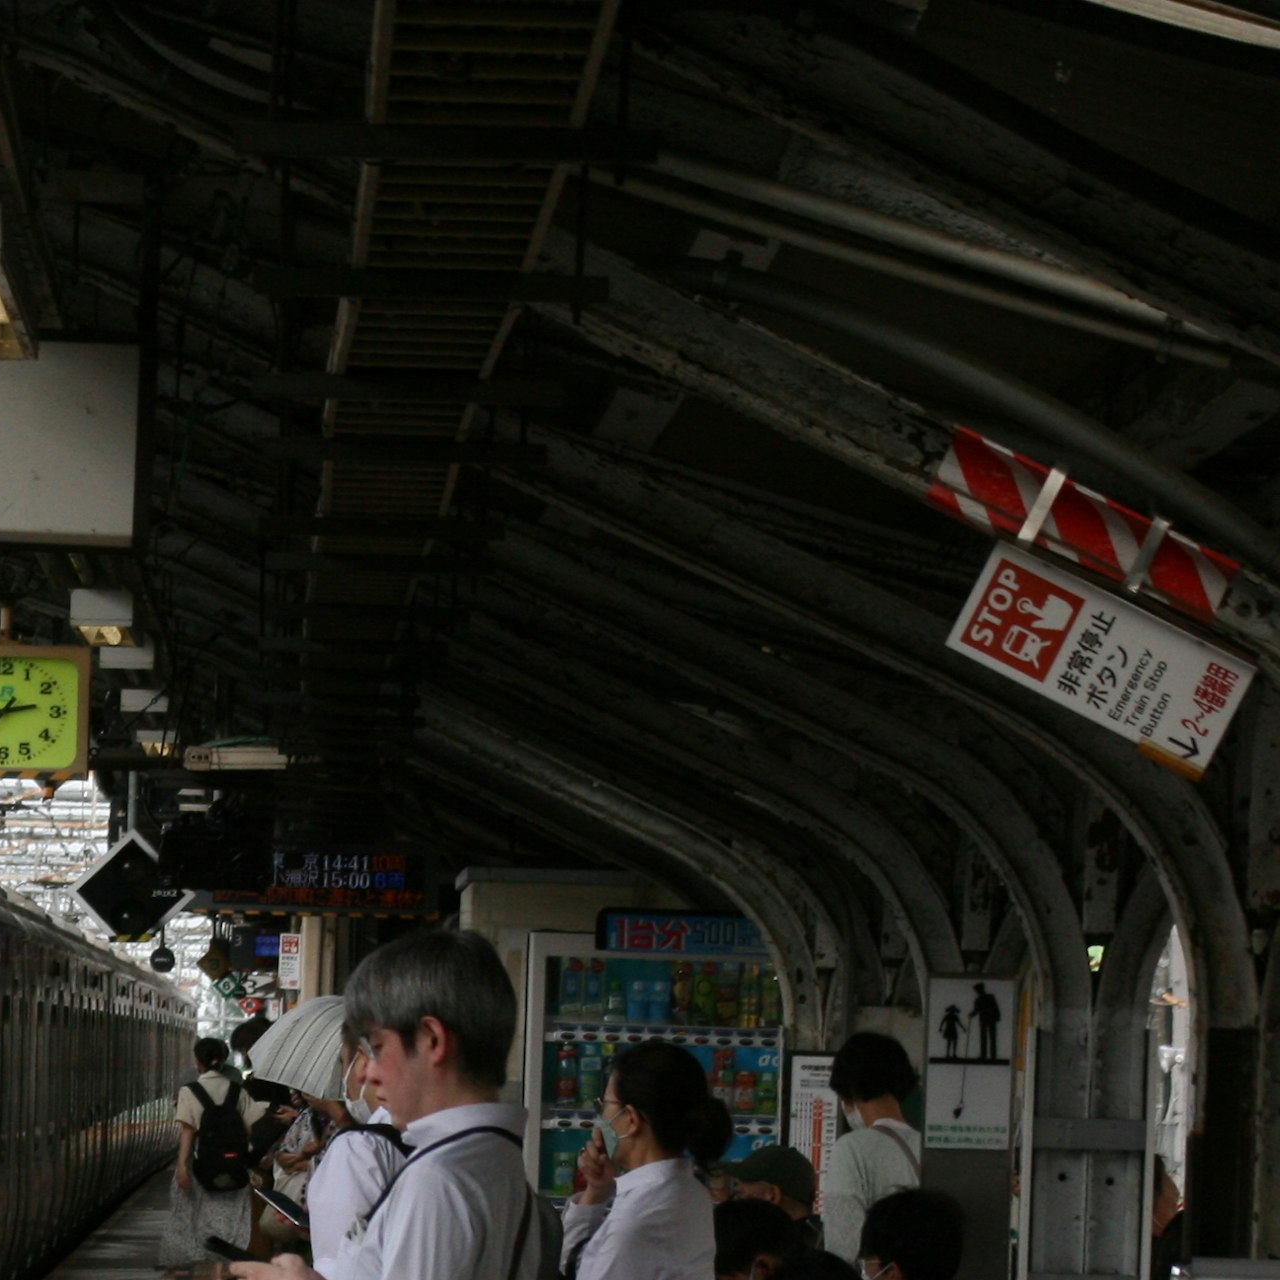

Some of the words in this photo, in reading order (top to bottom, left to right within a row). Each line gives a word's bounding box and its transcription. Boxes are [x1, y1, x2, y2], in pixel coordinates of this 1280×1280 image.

[970, 568, 1021, 647] STOP
[1056, 610, 1116, 696] 非常停止
[24, 669, 31, 681] 1
[1086, 646, 1128, 710] ボタン
[40, 682, 53, 695] 2
[1108, 648, 1153, 722] Emergency
[1125, 694, 1150, 727] Train
[1143, 661, 1168, 692] Stop
[49, 705, 61, 718] 3
[1140, 693, 1171, 737] Button
[38, 728, 51, 741] 4
[18, 743, 31, 755] 5
[322, 854, 369, 871] 14:41
[322, 872, 371, 889] 15:00
[221, 981, 231, 992] 6
